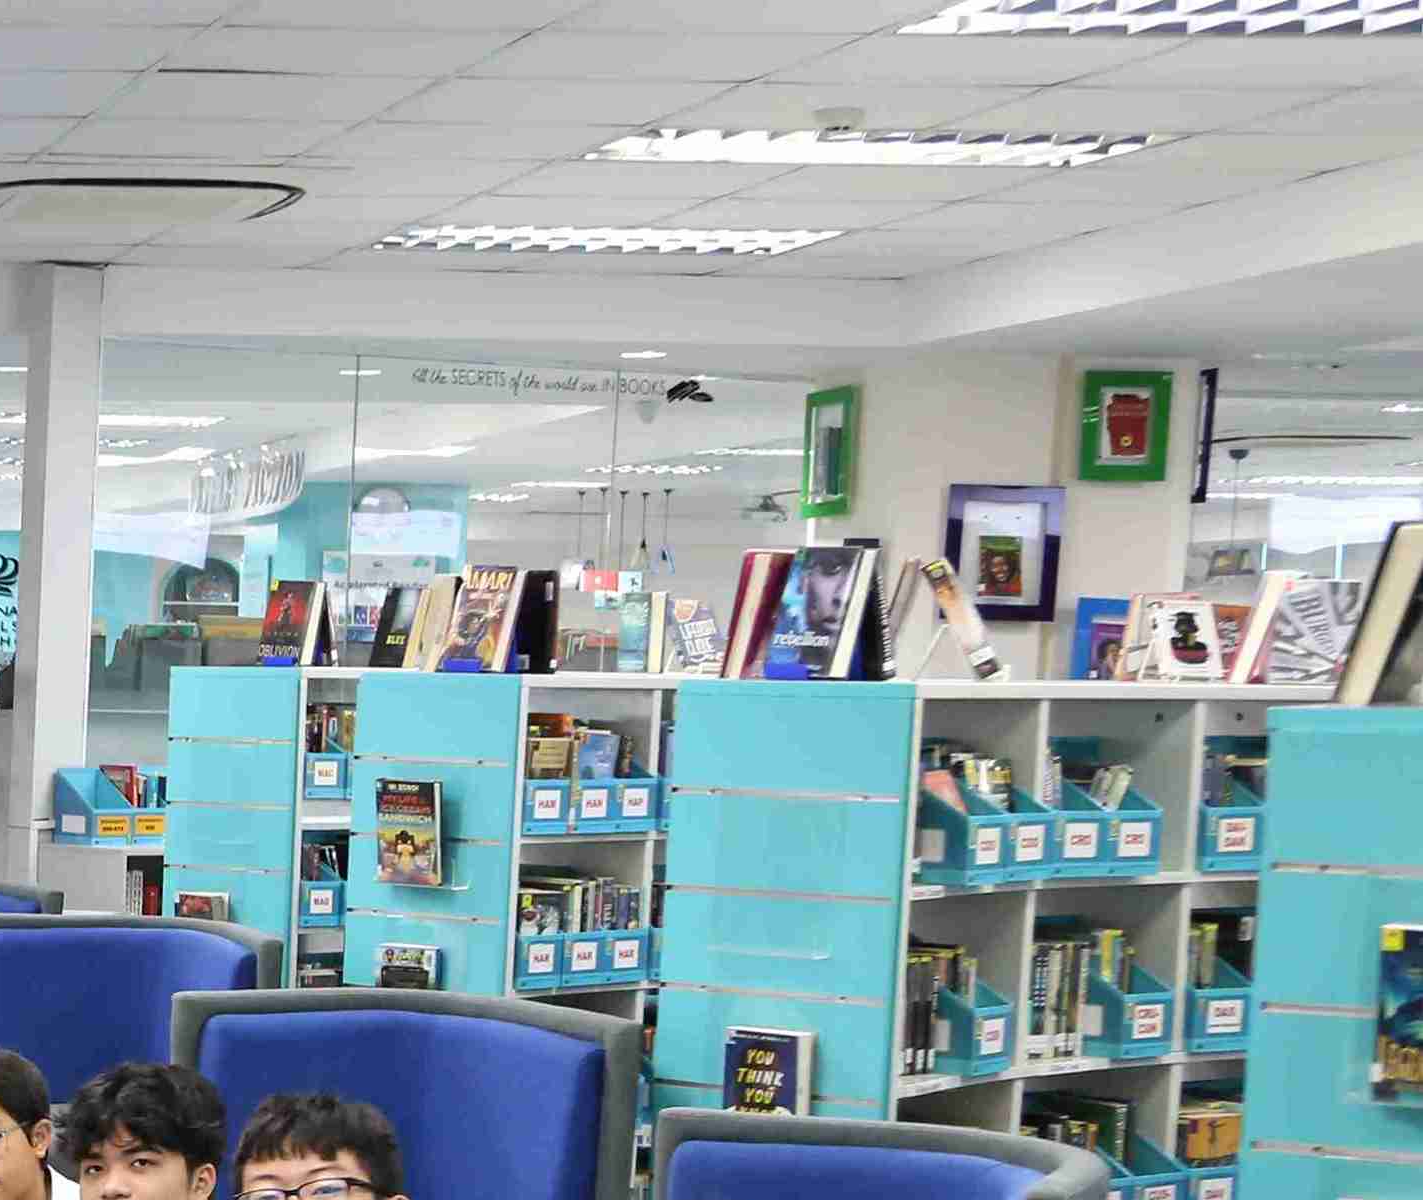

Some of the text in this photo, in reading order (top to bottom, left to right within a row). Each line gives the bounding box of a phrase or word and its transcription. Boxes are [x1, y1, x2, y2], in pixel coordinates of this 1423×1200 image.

[451, 368, 506, 387] SECRETS
[508, 370, 523, 397] of
[544, 376, 579, 392] world
[619, 377, 667, 396] BOOKS
[464, 563, 516, 591] AMARI
[771, 630, 831, 648] rebellion
[257, 642, 300, 658] OBLIVION
[745, 1047, 776, 1067] YOU
[736, 1066, 786, 1088] THINK
[743, 1086, 777, 1105] YOU
